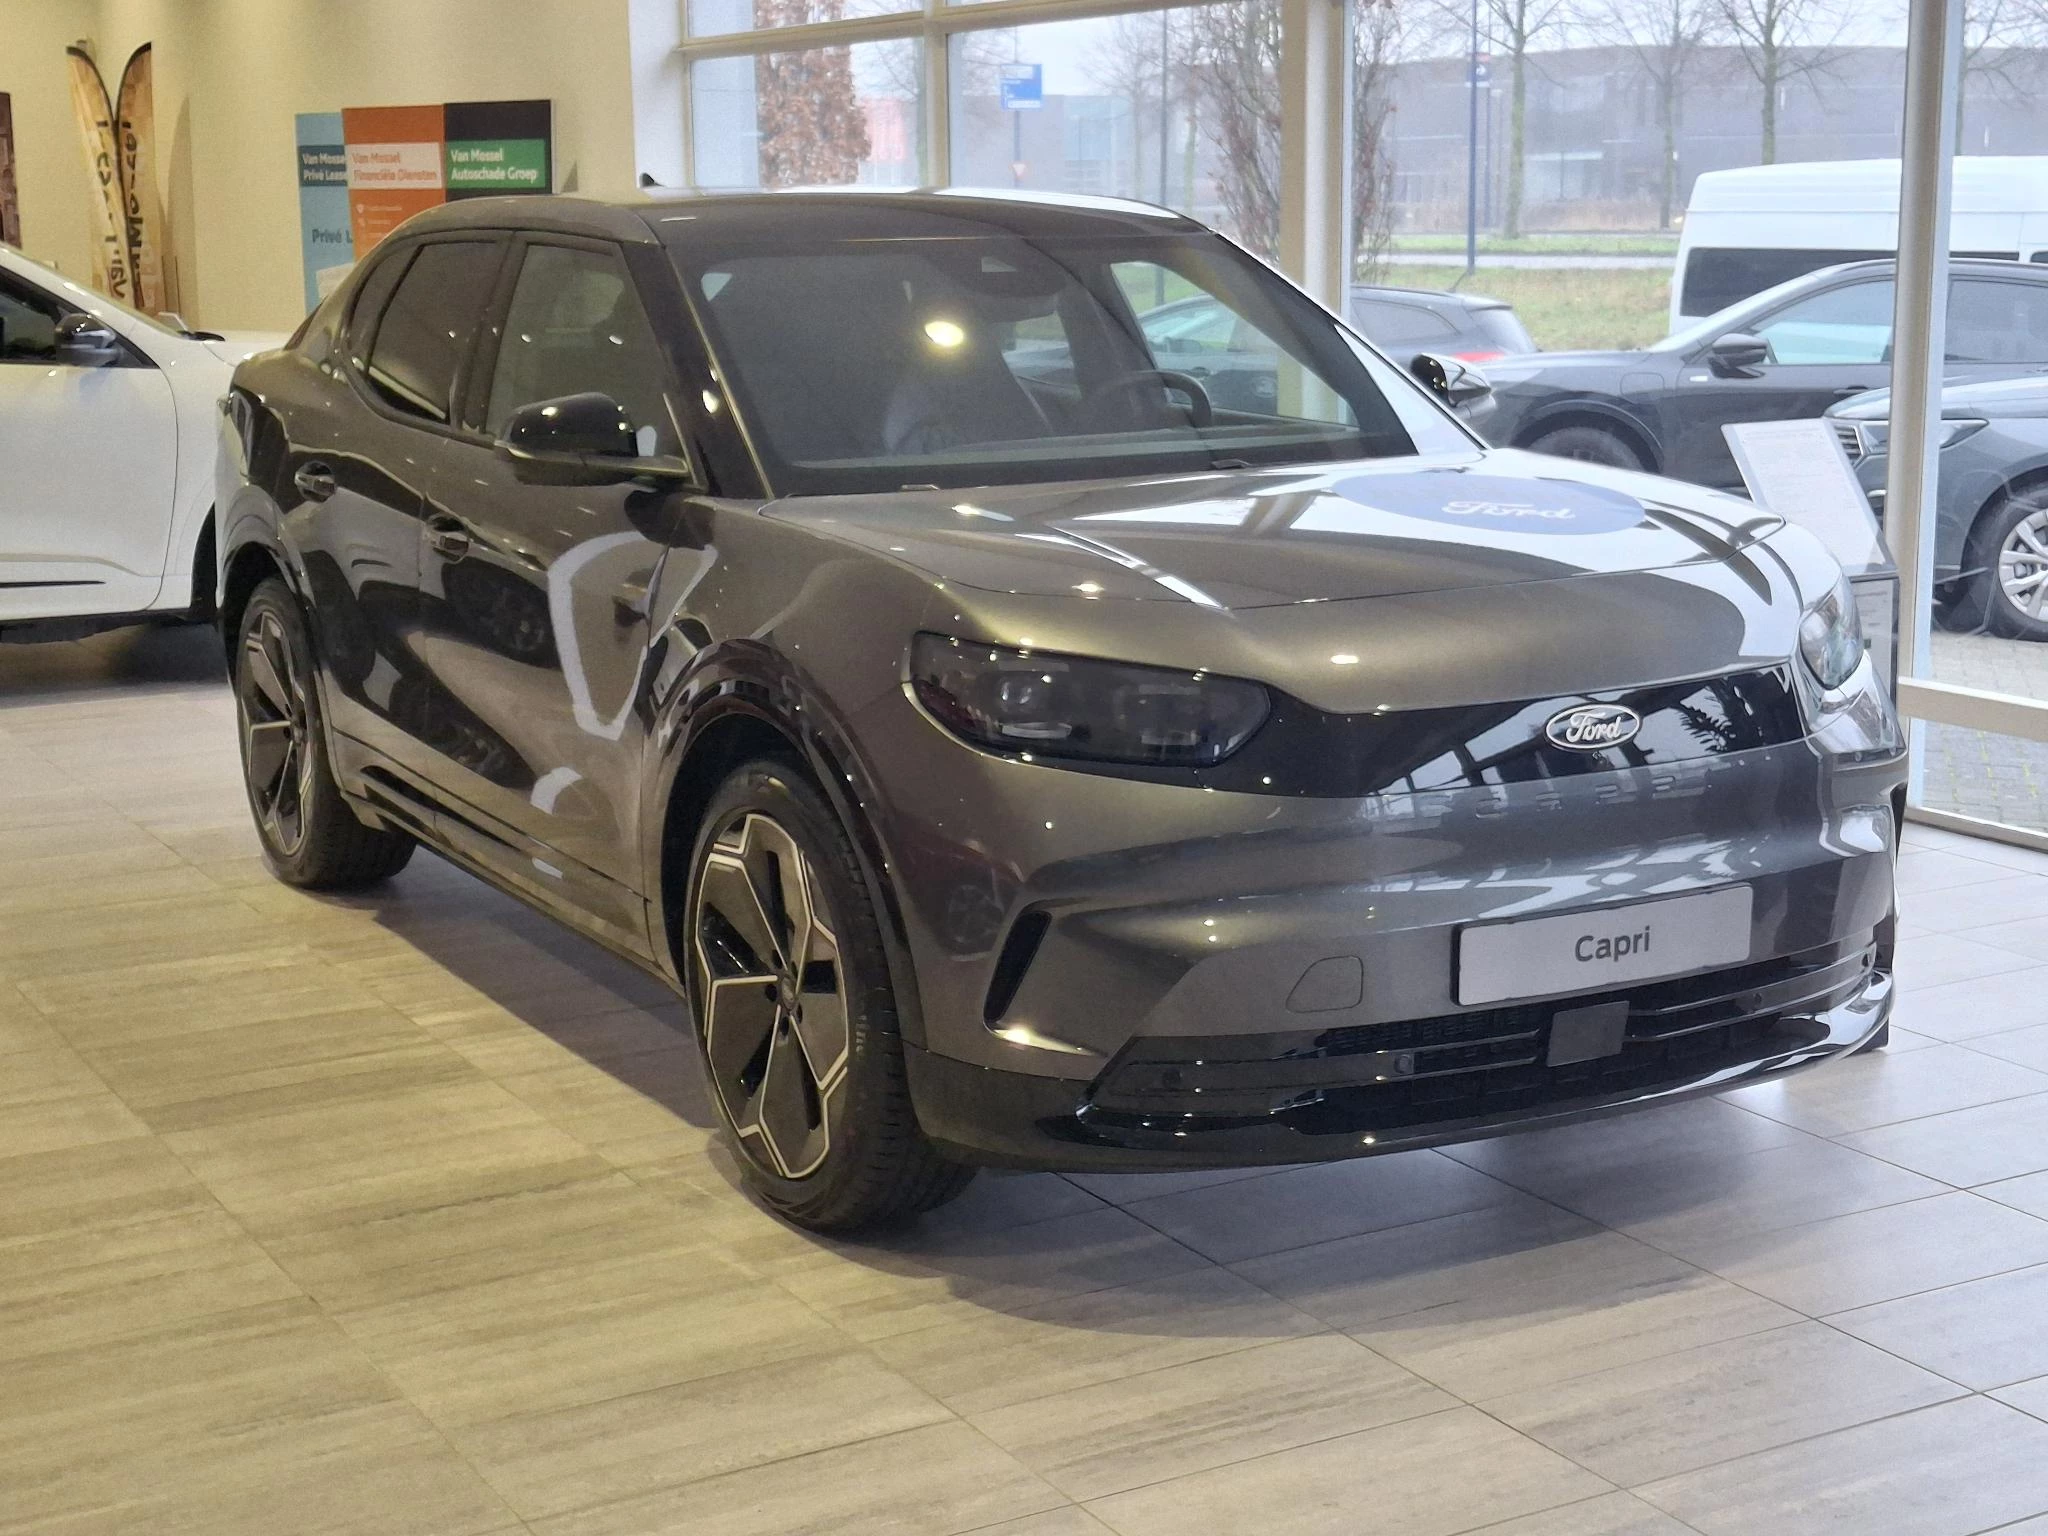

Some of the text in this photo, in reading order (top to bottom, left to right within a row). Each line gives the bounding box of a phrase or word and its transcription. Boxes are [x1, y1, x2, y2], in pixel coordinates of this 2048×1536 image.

[450, 148, 504, 162] Van Mossel
[507, 166, 538, 184] Groep
[1441, 500, 1577, 519] Ford
[1565, 711, 1622, 743] Ford
[1575, 925, 1650, 962] Capri
